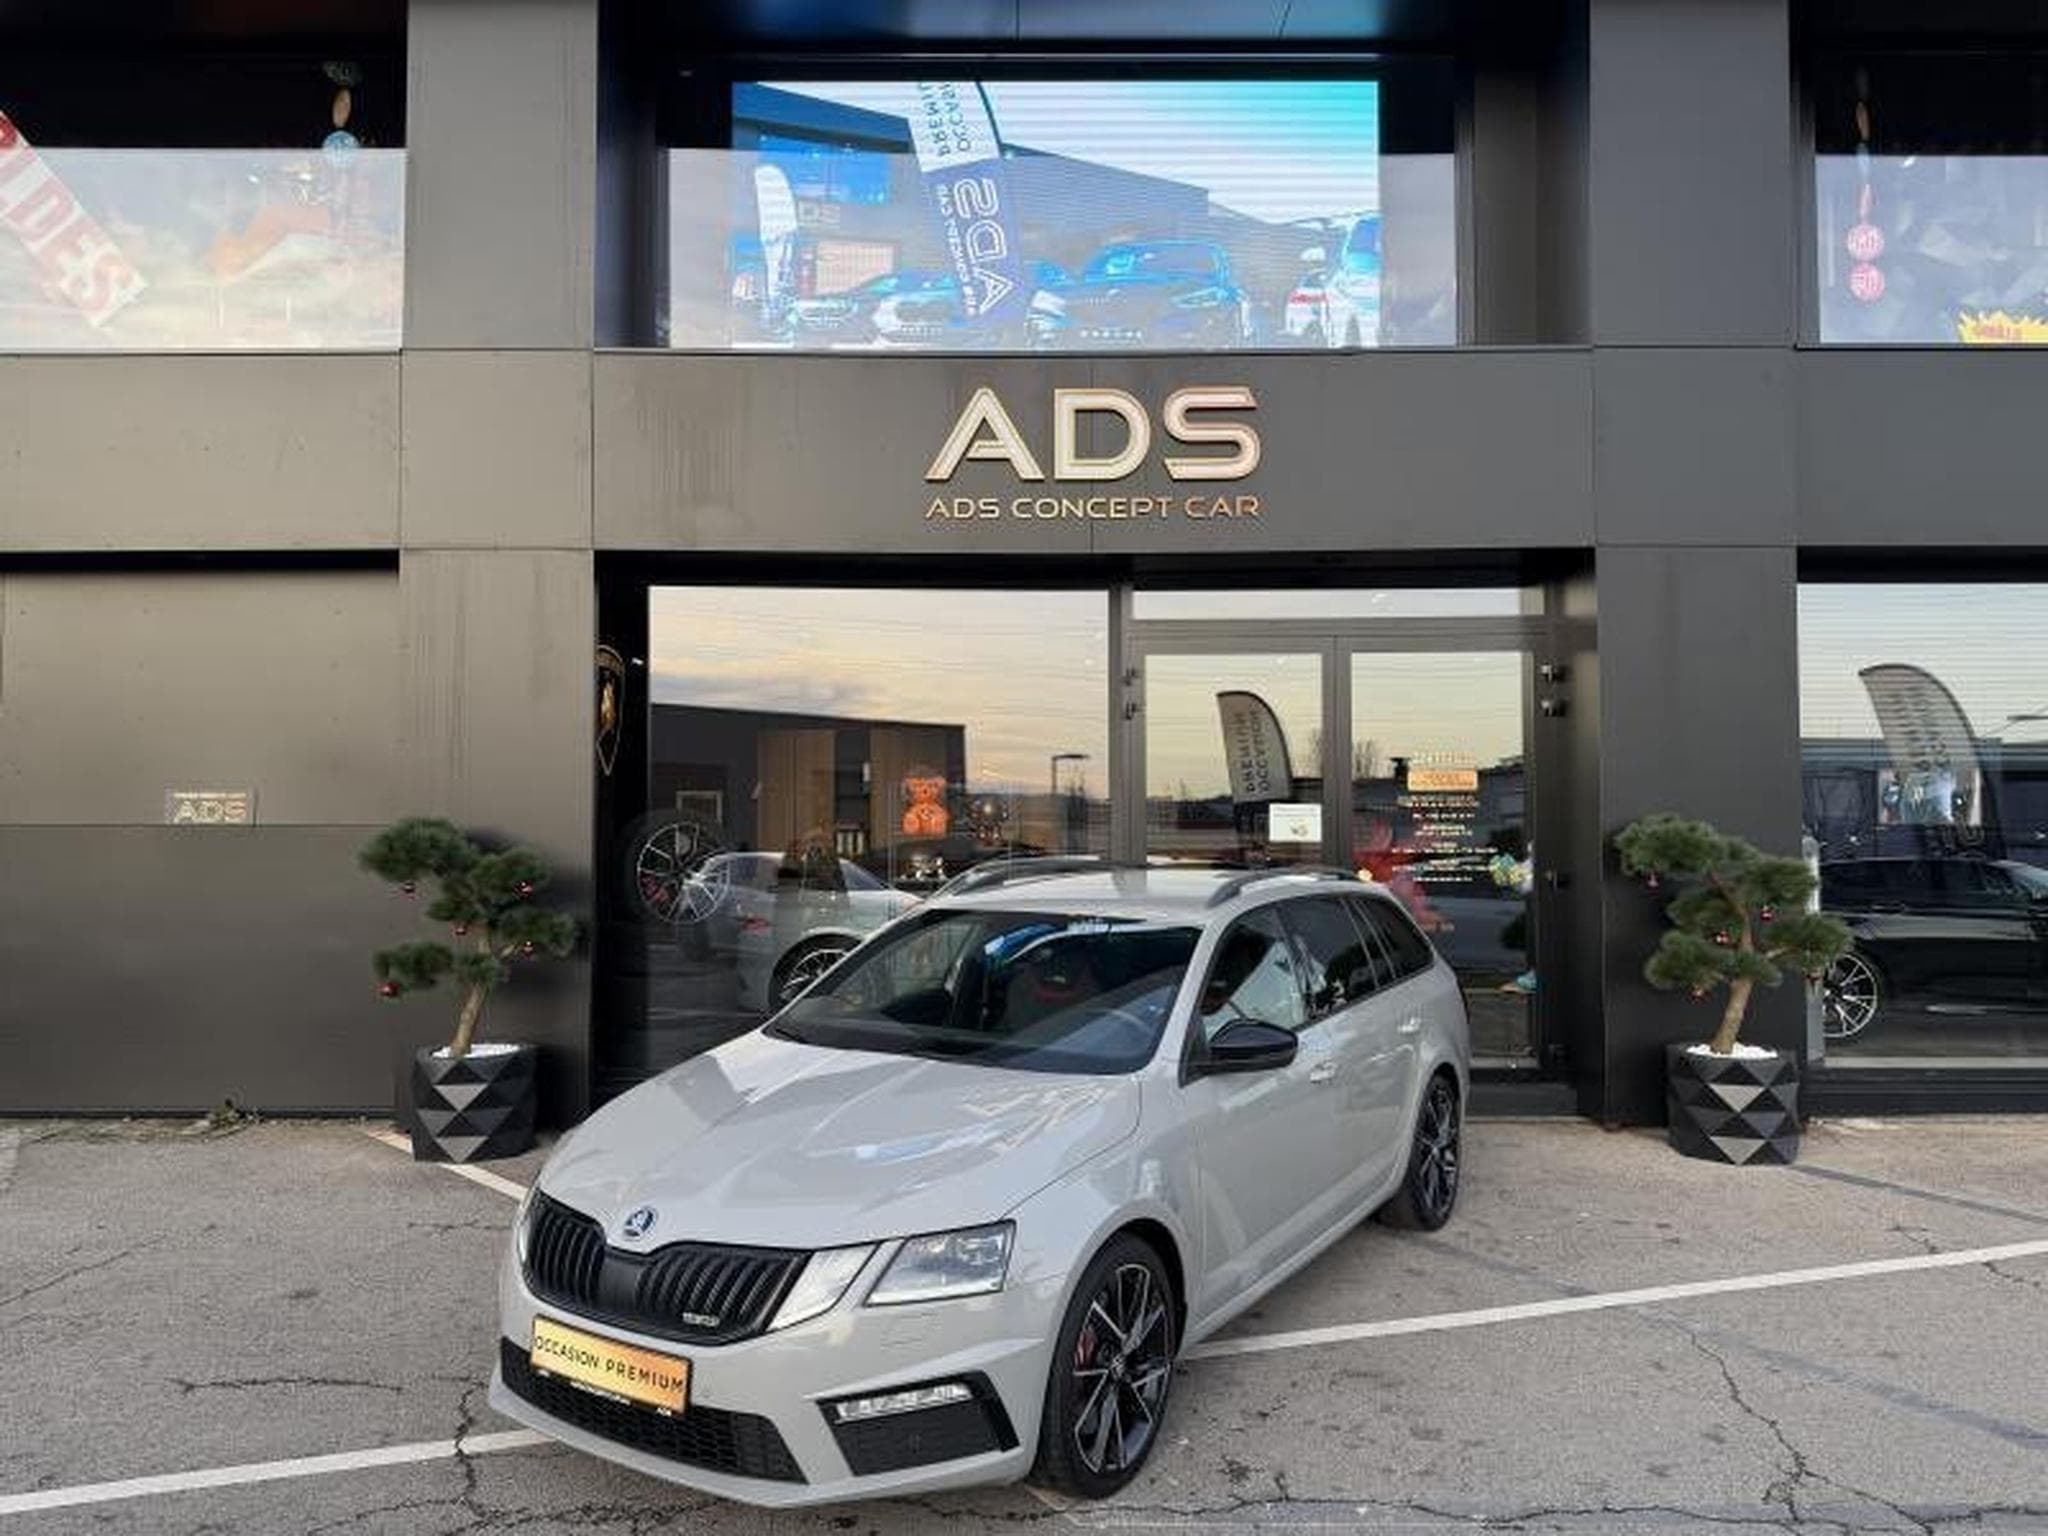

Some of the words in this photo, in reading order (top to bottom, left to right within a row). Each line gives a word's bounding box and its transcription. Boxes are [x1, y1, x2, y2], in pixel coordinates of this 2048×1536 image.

[924, 387, 1261, 481] ADS
[924, 498, 1000, 519] ADS
[1011, 498, 1173, 520] CONCEPT
[1186, 496, 1260, 519] CAR
[174, 800, 247, 823] ADS
[534, 1335, 601, 1369] OCCASION
[605, 1359, 685, 1394] PREMIUM
